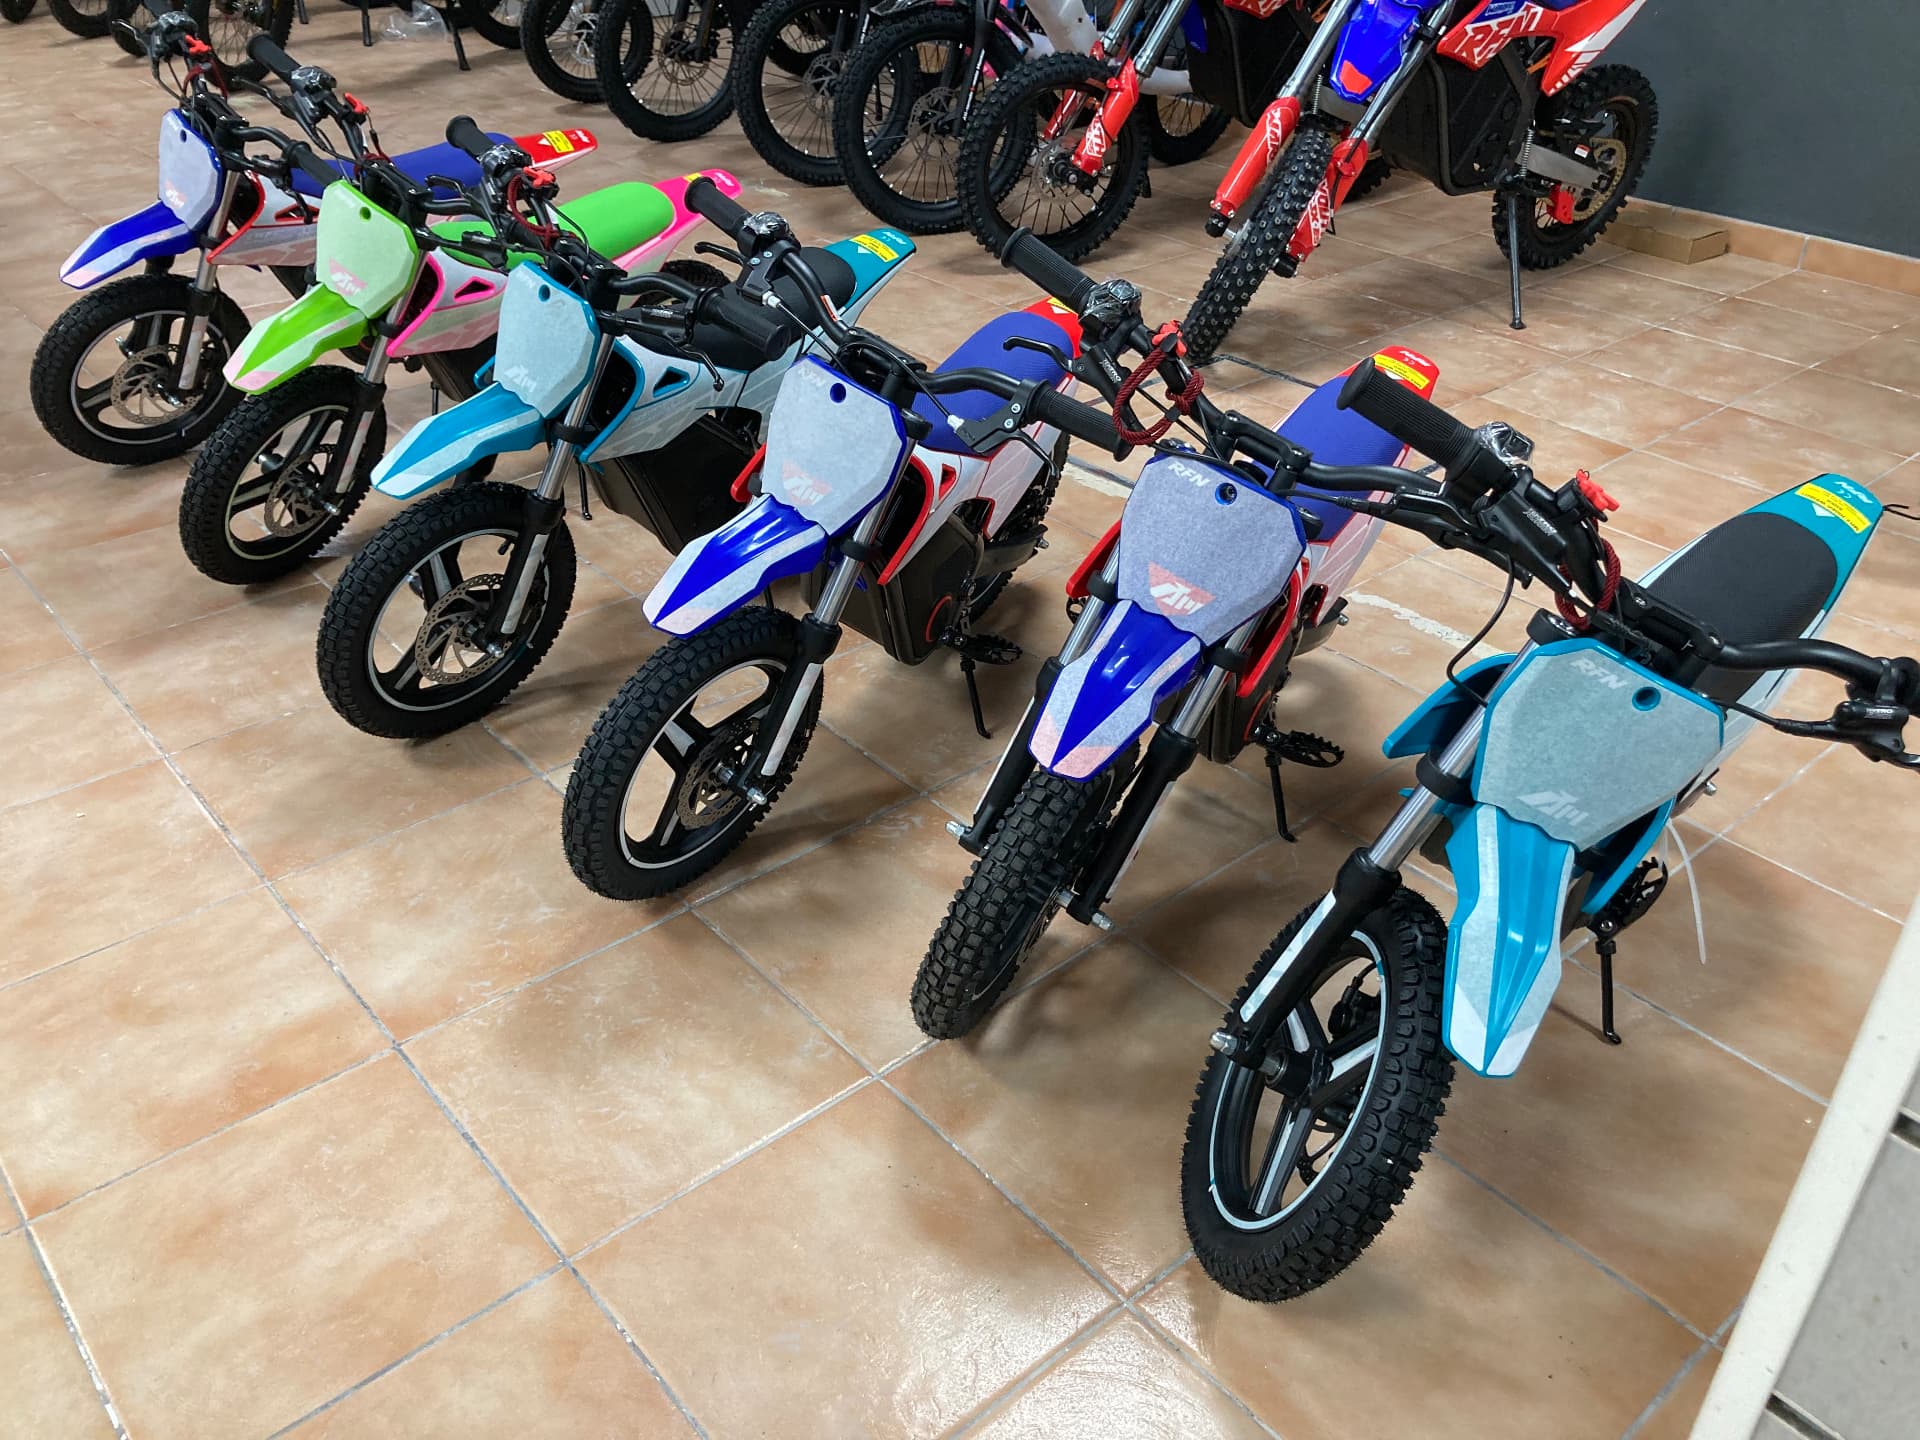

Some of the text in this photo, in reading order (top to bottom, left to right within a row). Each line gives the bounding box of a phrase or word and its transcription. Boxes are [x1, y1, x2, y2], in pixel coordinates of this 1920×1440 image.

[1455, 2, 1544, 65] RFN
[1167, 461, 1212, 487] RFN
[1569, 657, 1630, 690] RFN
